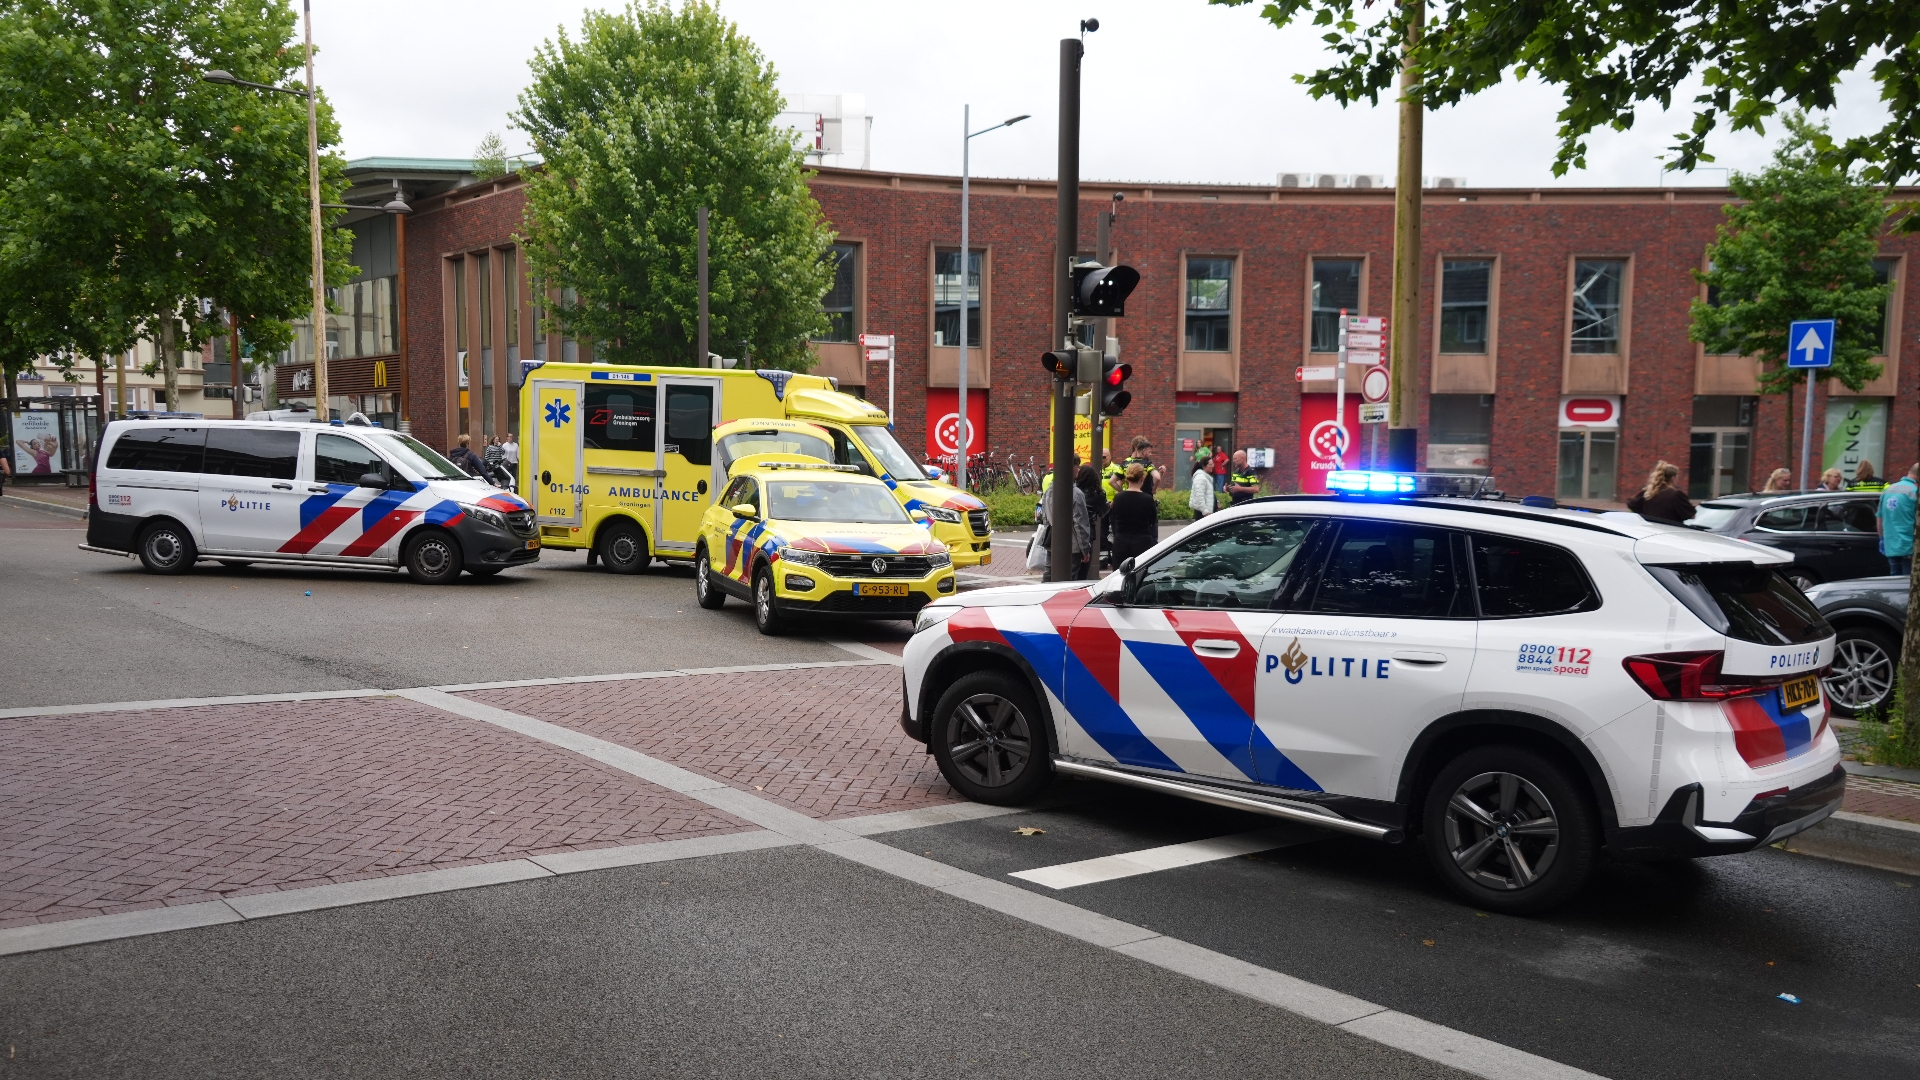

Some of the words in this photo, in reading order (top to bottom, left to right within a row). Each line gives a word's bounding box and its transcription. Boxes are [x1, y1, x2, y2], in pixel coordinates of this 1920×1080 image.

[1311, 461, 1345, 470] Kruidvt
[550, 483, 590, 495] 01-146
[608, 486, 699, 502] AMBULANCE
[862, 584, 904, 595] G-953-RL
[1520, 643, 1555, 655] 0900
[1518, 653, 1553, 665] 8844
[1557, 646, 1592, 665] 112
[1770, 651, 1811, 668] POLITIE
[1553, 665, 1589, 675] spoed
